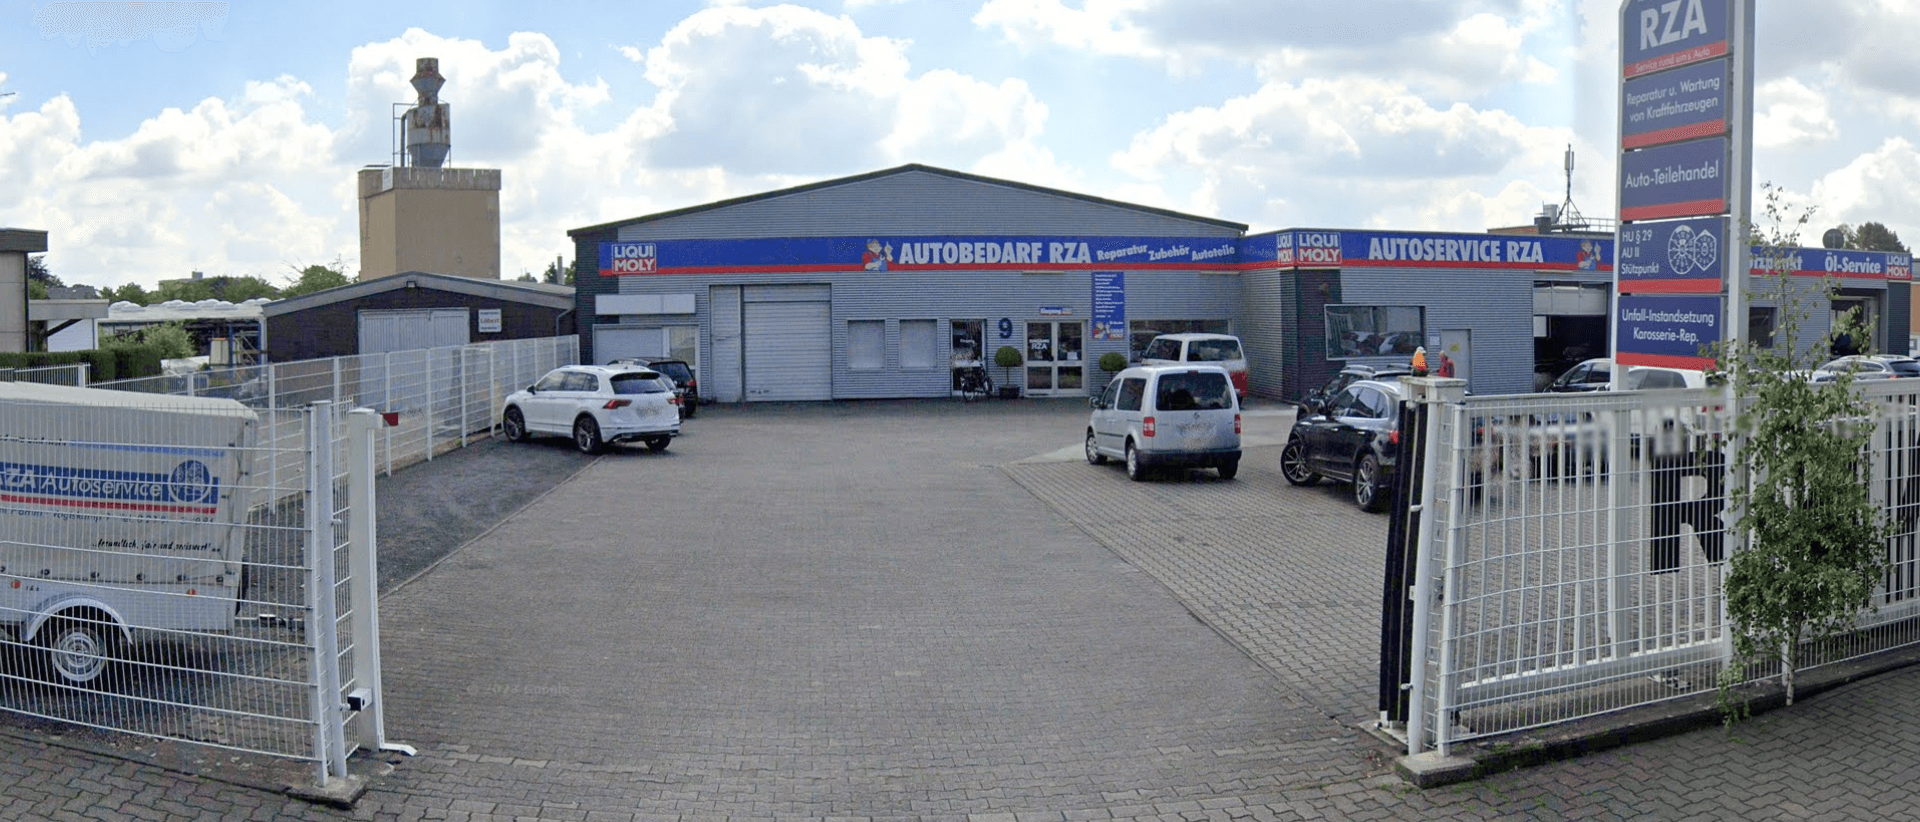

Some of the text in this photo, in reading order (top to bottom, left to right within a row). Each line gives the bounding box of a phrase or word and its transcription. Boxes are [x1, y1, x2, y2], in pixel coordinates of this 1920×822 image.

[1640, 0, 1707, 51] RZA
[1627, 86, 1666, 106] Reparatur
[1680, 77, 1720, 94] Wartung
[1630, 97, 1718, 122] von Kraftfahrzeugen
[1625, 159, 1719, 189] Auto-Teilehandel
[1298, 233, 1339, 248] LIQUI
[1622, 230, 1634, 243] HU
[1642, 229, 1653, 242] 29
[614, 245, 654, 258] LIQUI
[899, 242, 1092, 264] AUTOBEDARF RZA
[1096, 244, 1148, 261] Reparatur
[1148, 244, 1190, 261] Zubehör
[1191, 244, 1235, 261] Autoteile
[1299, 248, 1340, 262] MOLY
[1368, 237, 1544, 263] AUTOSERVICE RZA
[1621, 247, 1633, 259] AU
[614, 259, 655, 271] MOLY
[1824, 252, 1881, 273] Öl-Service
[1886, 254, 1909, 266] LIQUI
[1621, 263, 1659, 277] Stützpunkt
[1886, 266, 1909, 277] MOLY
[1622, 308, 1714, 327] Unfall-Instandsetzung
[998, 317, 1013, 339] 9
[1633, 327, 1700, 345] Karosserie-Rep.
[1031, 342, 1048, 350] RZA
[0, 467, 162, 498] ZA Autoservice
